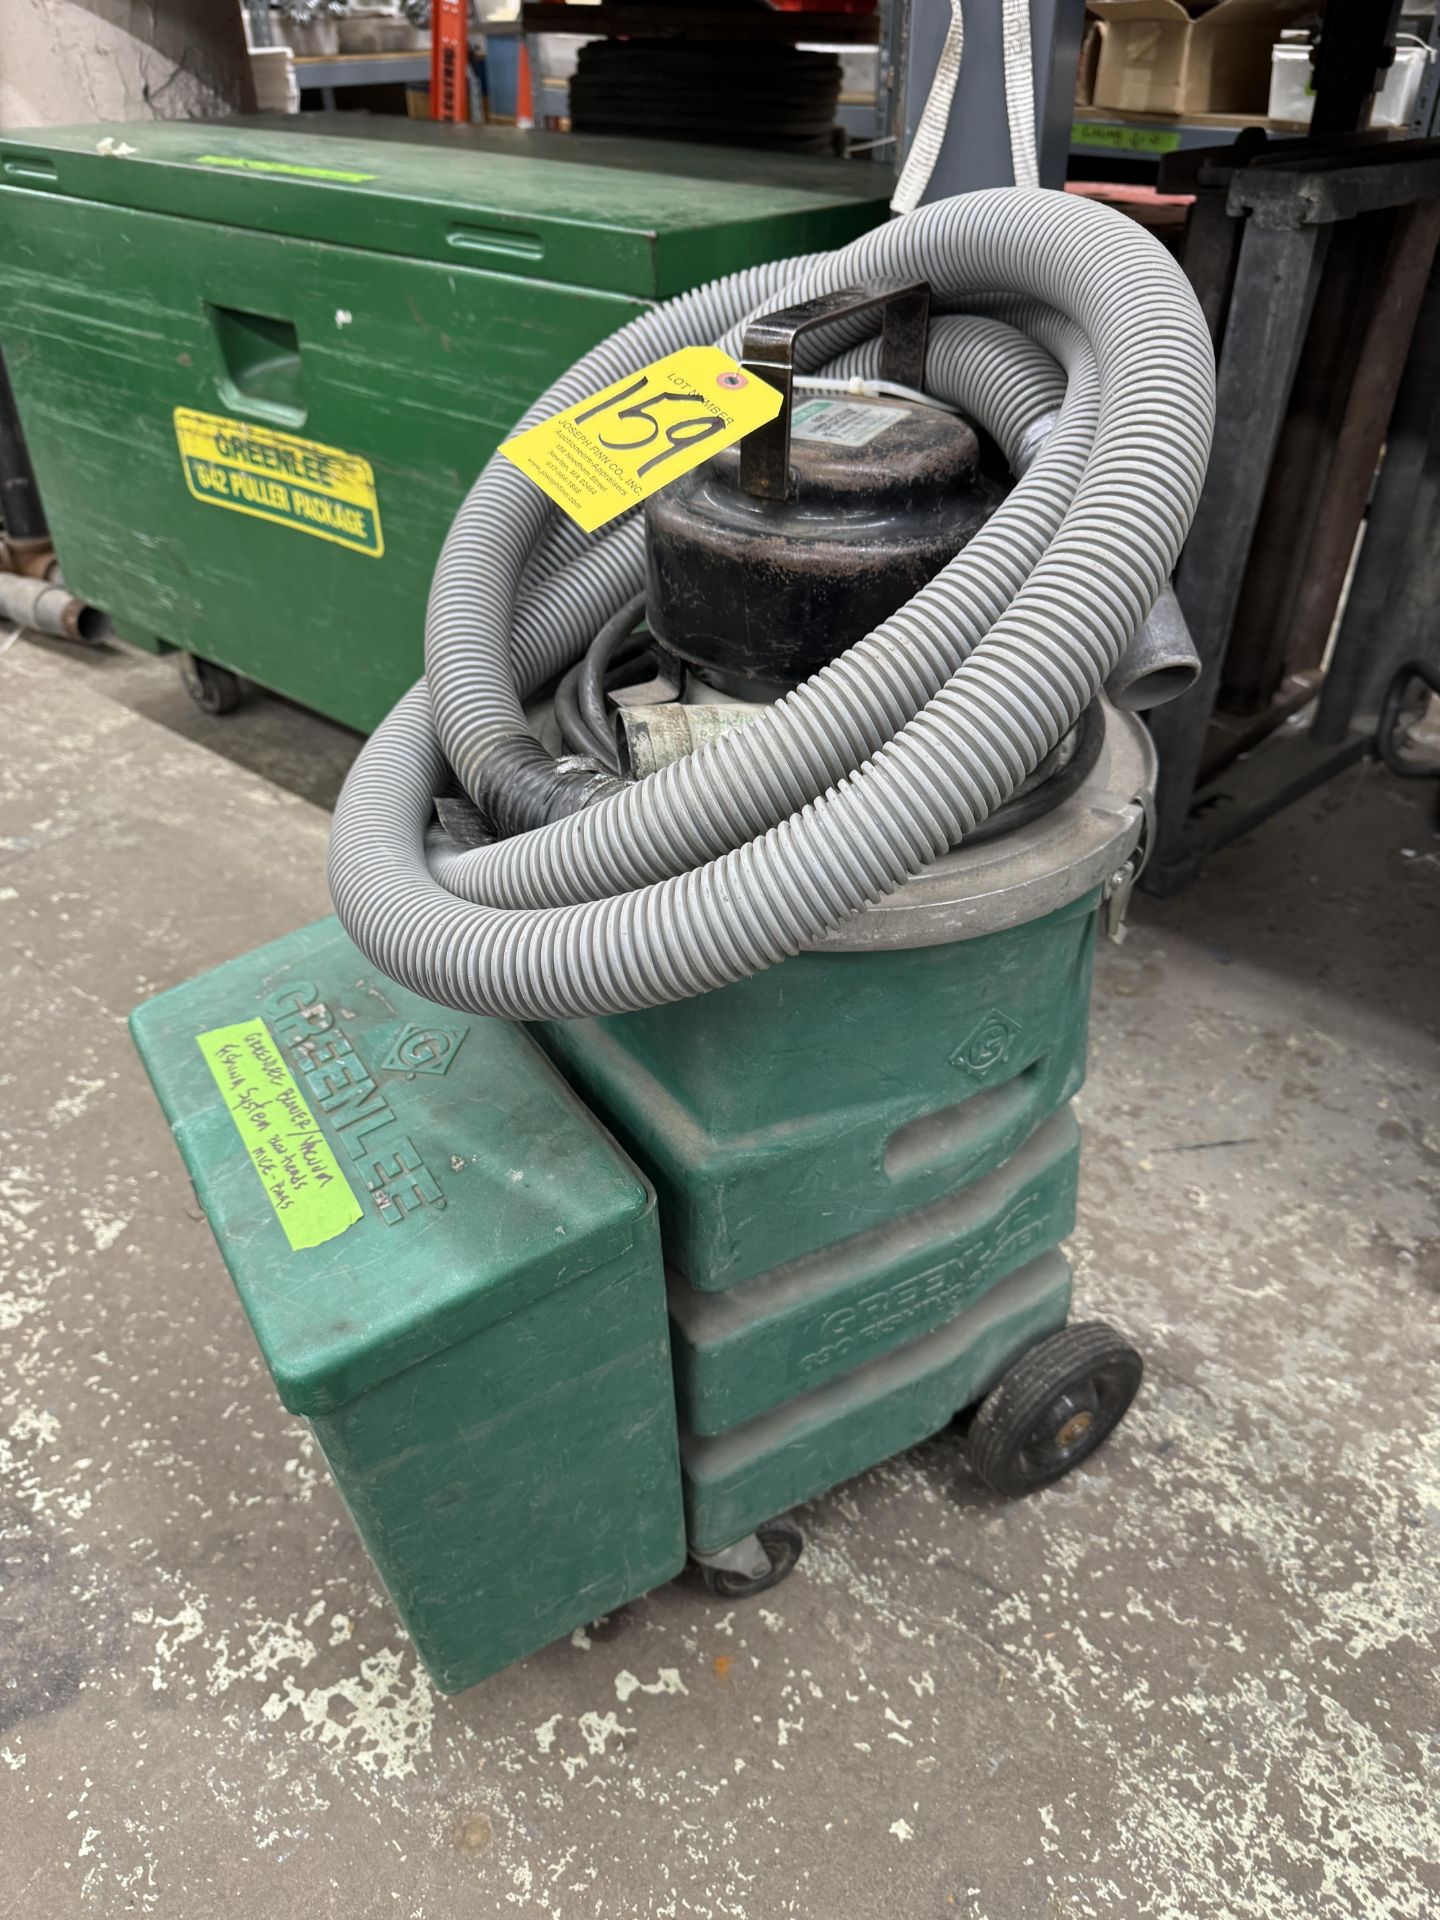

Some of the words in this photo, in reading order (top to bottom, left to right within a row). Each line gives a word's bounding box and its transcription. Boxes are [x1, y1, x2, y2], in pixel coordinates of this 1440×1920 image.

[574, 375, 727, 478] 159
[667, 373, 691, 390] LOT
[688, 389, 734, 426] NMBER
[558, 419, 593, 447] JOSEPH
[590, 446, 610, 464] FINN
[625, 478, 643, 497] INC.
[229, 471, 291, 513] PULLER
[291, 489, 368, 539] PACKAGE
[264, 979, 445, 1227] GREENLEE
